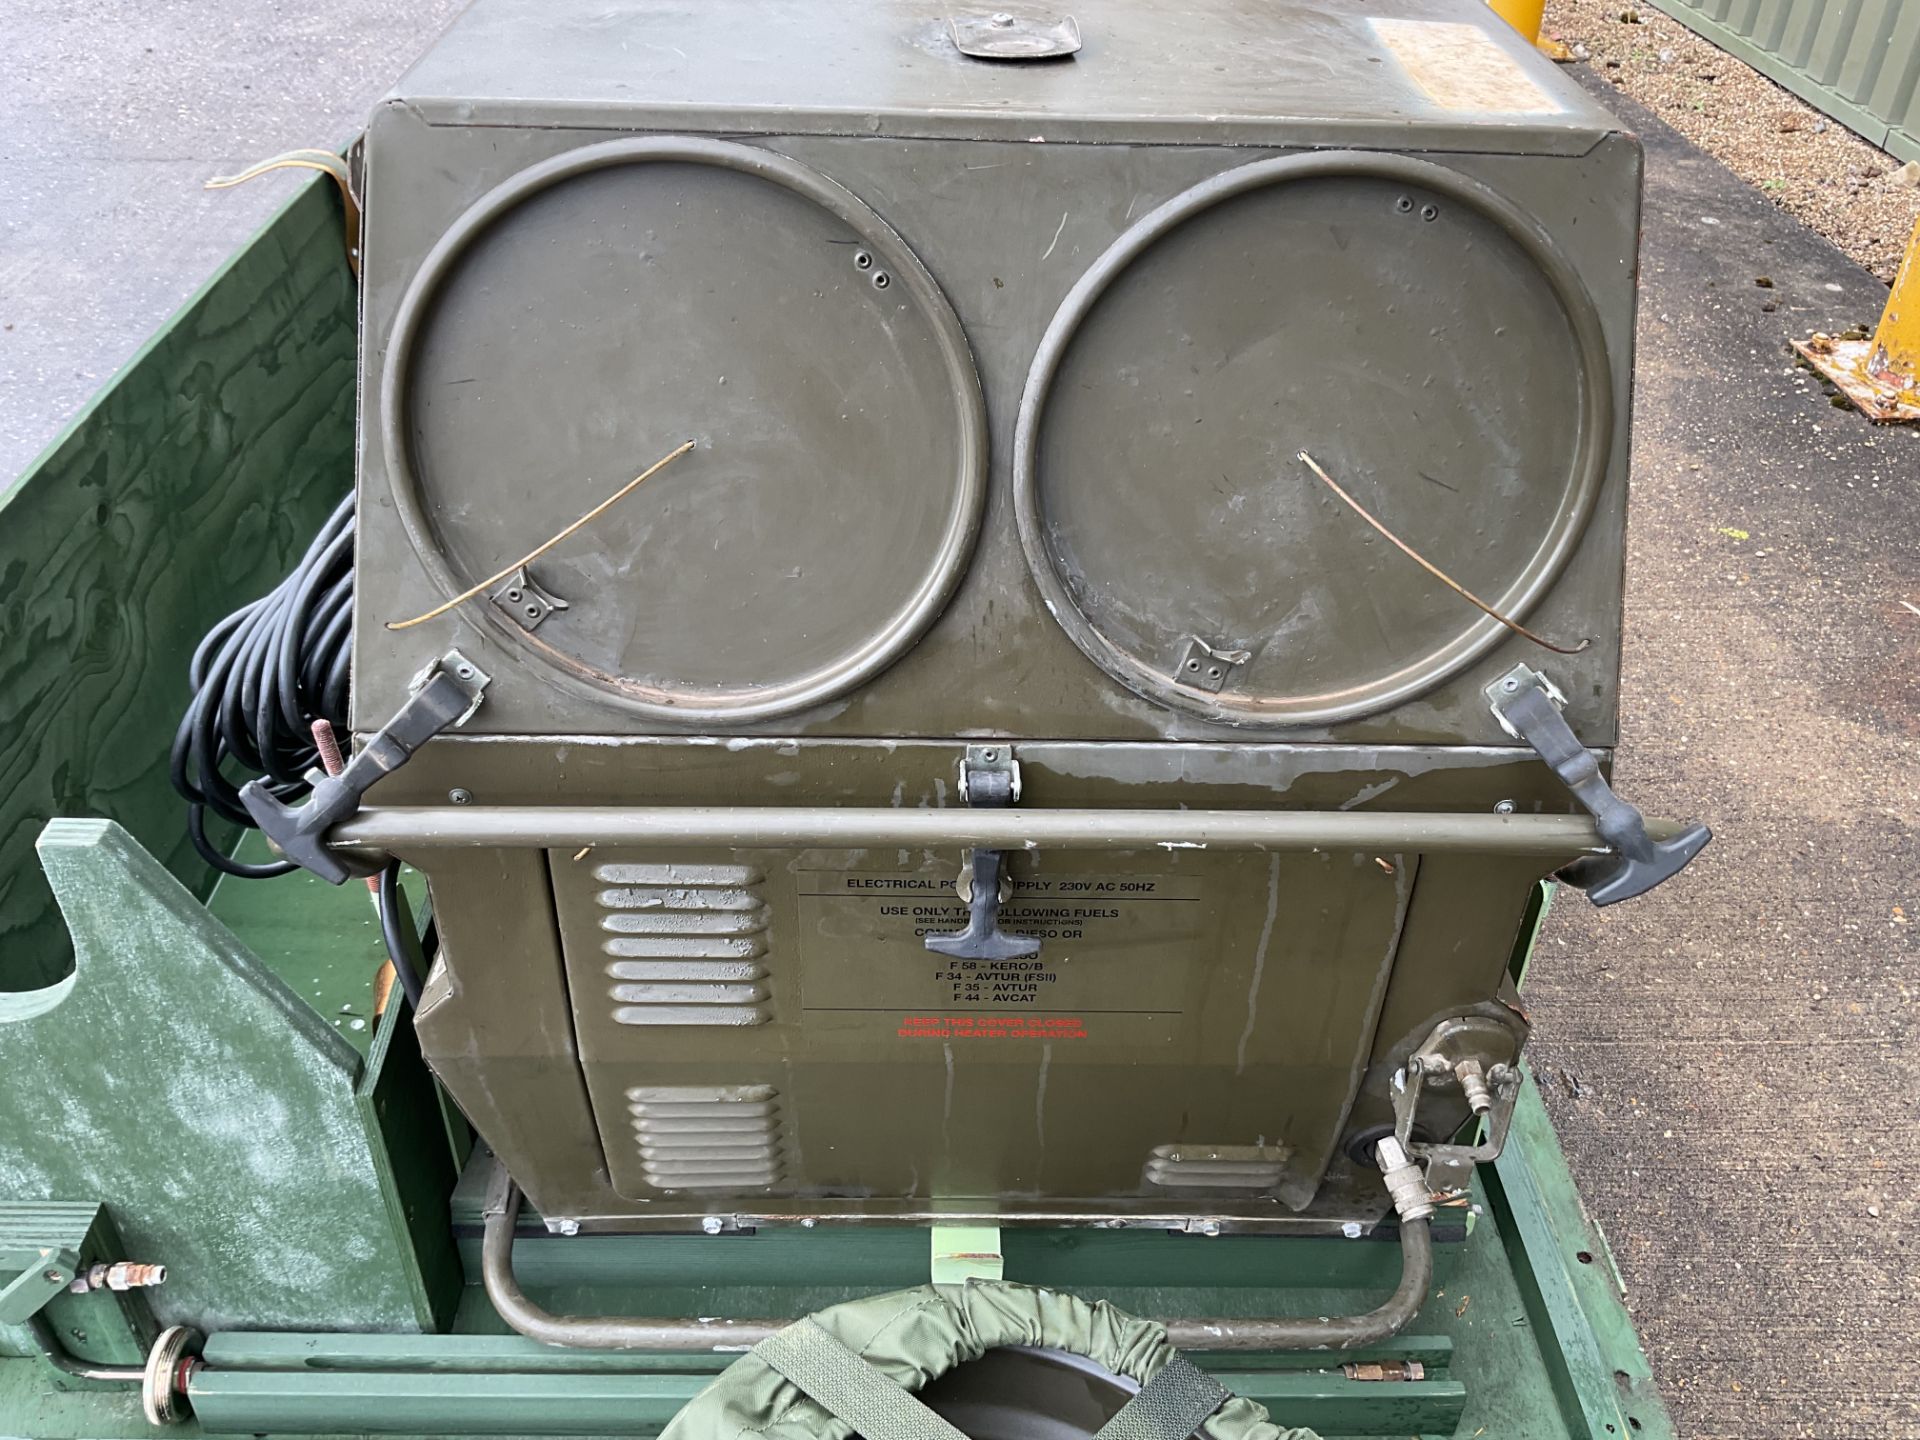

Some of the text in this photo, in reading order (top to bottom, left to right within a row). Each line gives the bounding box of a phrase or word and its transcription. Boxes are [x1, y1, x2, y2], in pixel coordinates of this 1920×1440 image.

[847, 879, 936, 889] ELECTRICAL
[1013, 882, 1052, 890] PPLY
[1059, 882, 1093, 891] 230V
[1096, 882, 1116, 891] AC
[1120, 883, 1156, 892] 50HZ
[881, 907, 908, 916] USE
[913, 907, 950, 916] ONLY
[997, 908, 1070, 917] OLLOWING
[1074, 909, 1119, 918] FUELS
[1062, 930, 1082, 938] OR
[950, 962, 958, 970] F
[962, 962, 977, 970] 58
[990, 962, 1043, 970] KERO/B
[935, 972, 943, 980] F
[947, 972, 962, 980] 34
[974, 973, 1020, 981] AVTUR
[953, 983, 961, 991] F
[965, 983, 980, 991] 35
[992, 983, 1038, 992] AVTUR
[953, 993, 961, 1001] F
[965, 993, 980, 1001] 44
[992, 994, 1037, 1002] AVCAT
[944, 1017, 974, 1027] THIS
